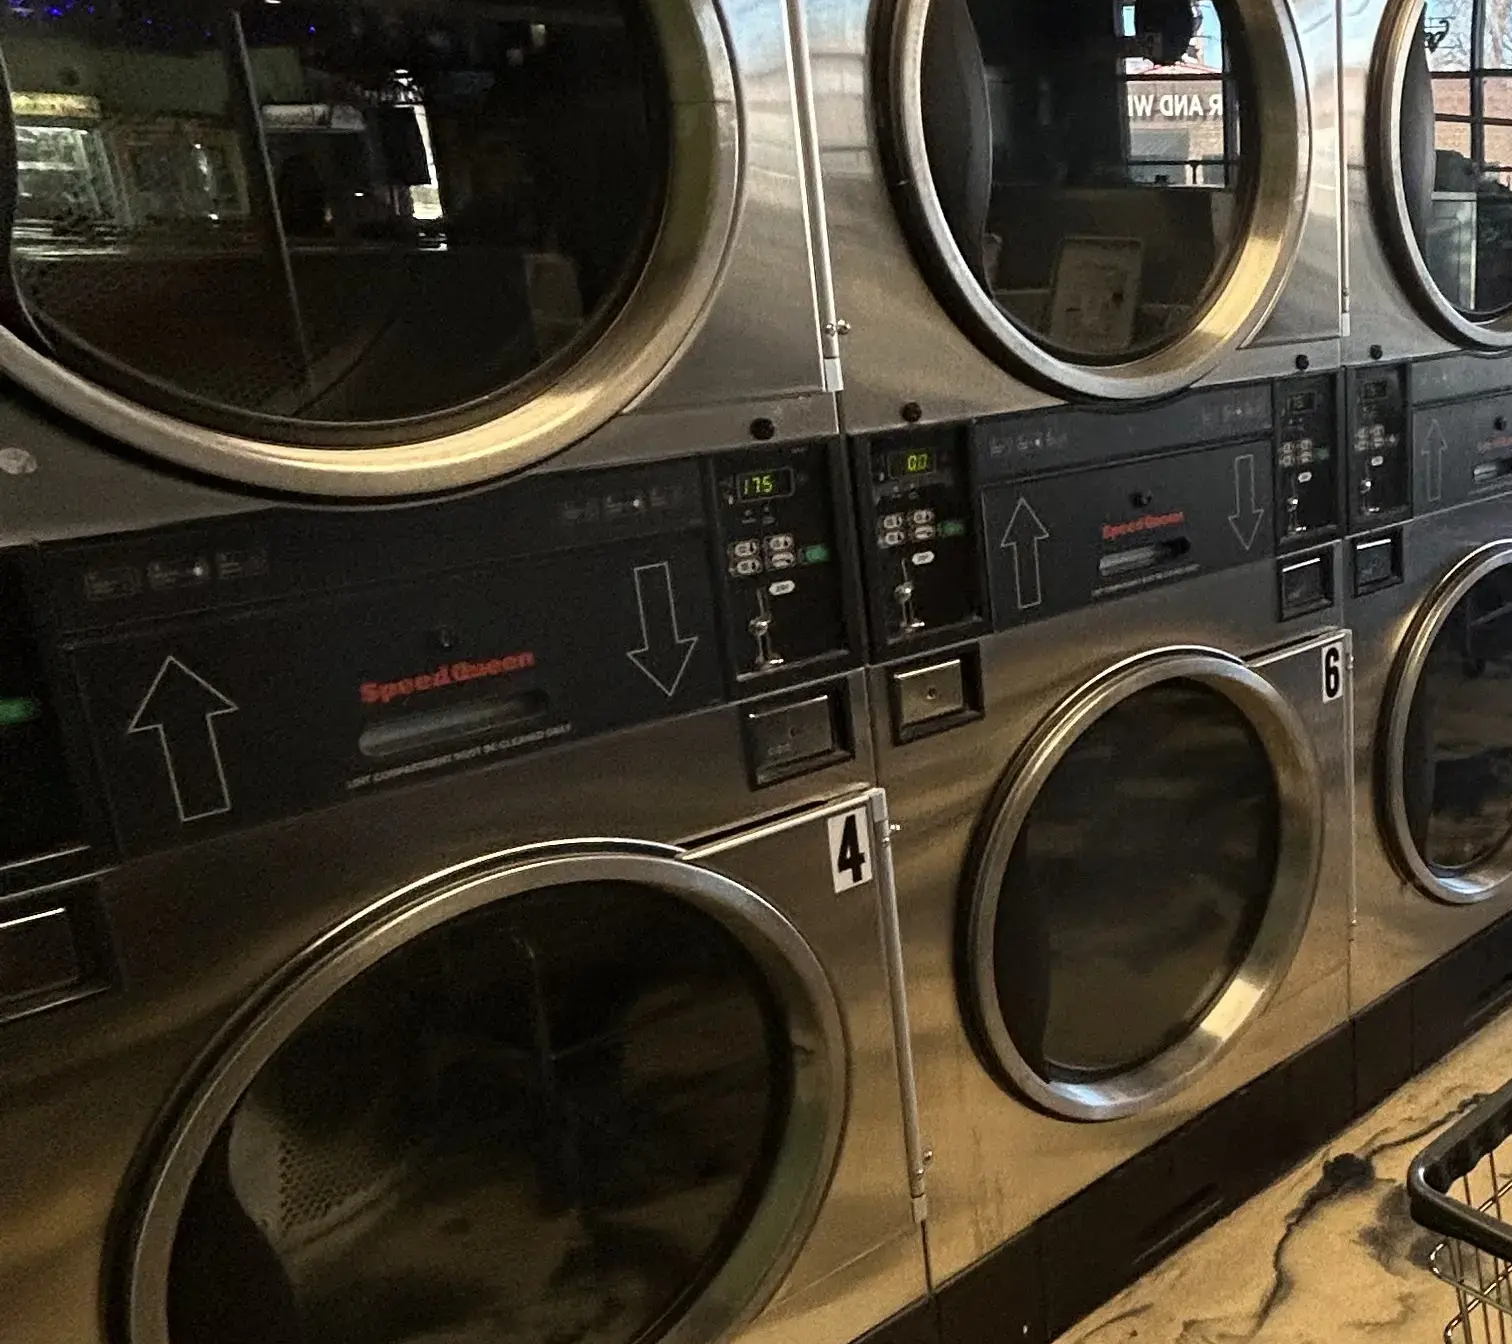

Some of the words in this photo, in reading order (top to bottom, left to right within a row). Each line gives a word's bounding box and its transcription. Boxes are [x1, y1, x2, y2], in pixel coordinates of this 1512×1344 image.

[743, 474, 774, 495] 175
[1325, 647, 1340, 698] 6
[838, 814, 866, 883] 4
